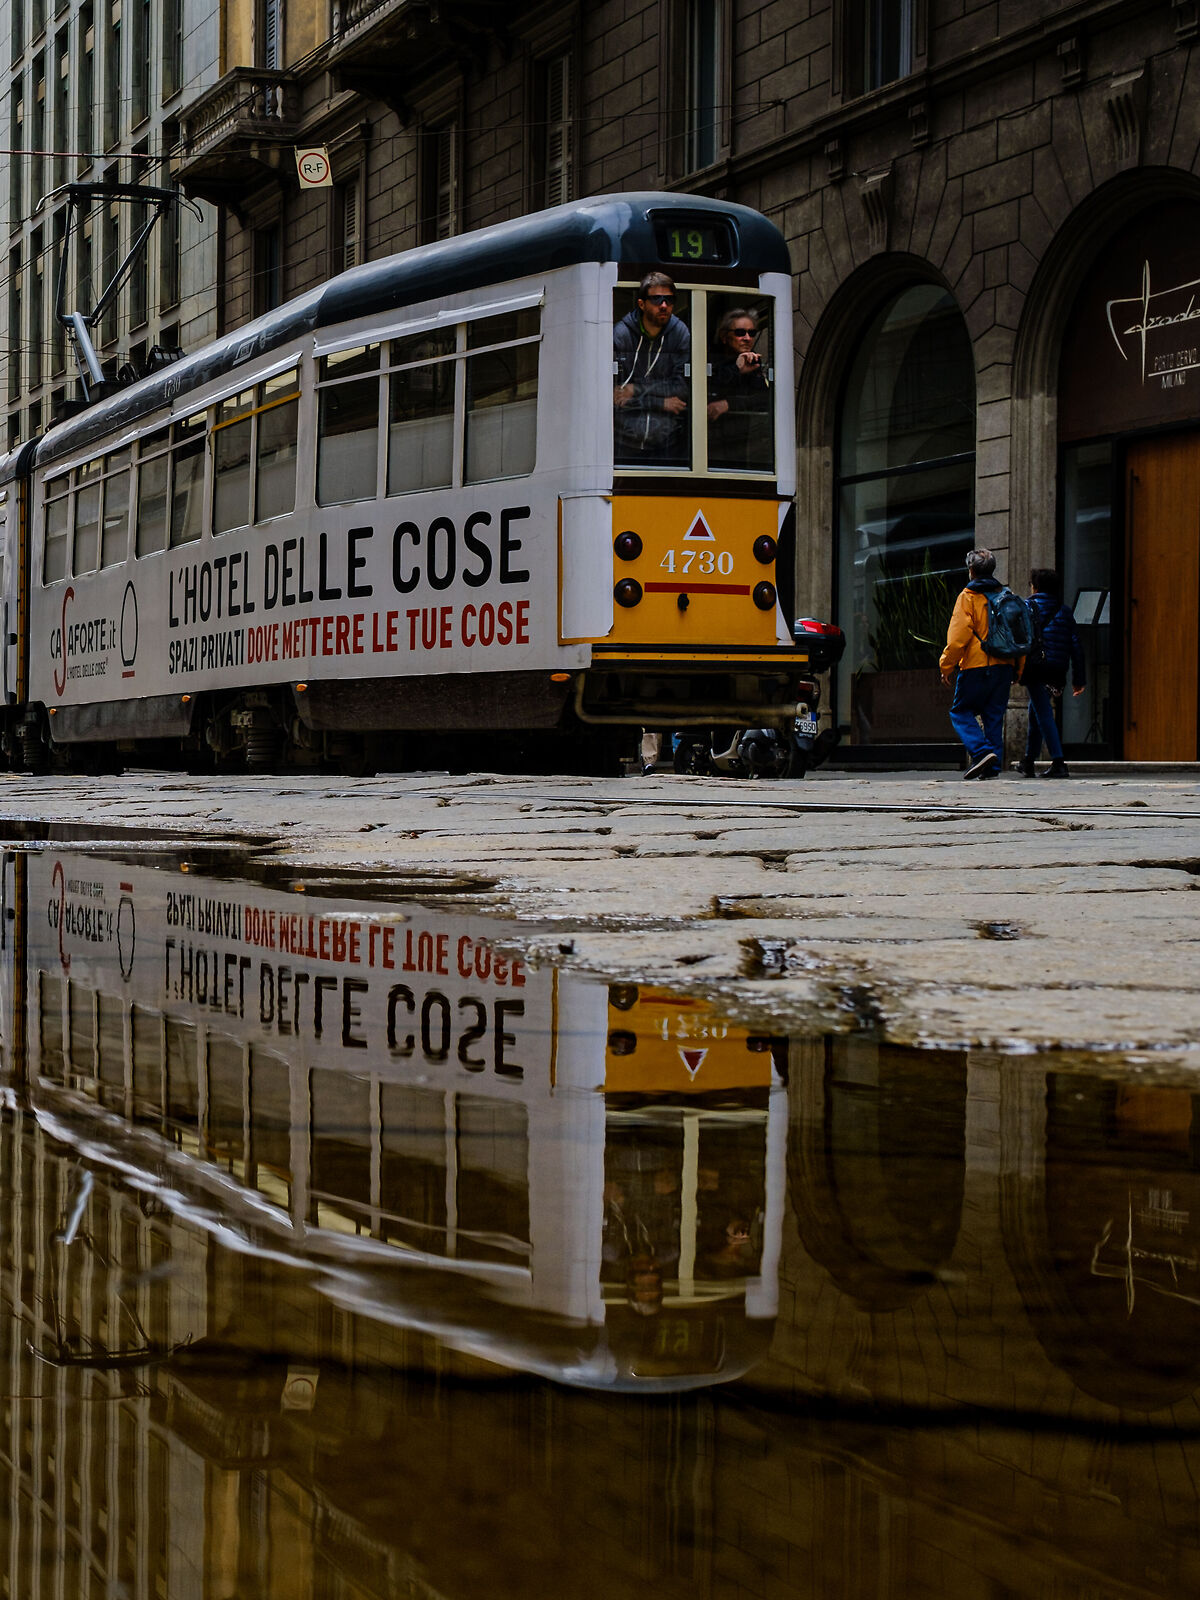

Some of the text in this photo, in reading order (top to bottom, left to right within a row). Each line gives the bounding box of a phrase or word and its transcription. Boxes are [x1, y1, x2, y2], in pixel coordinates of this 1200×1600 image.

[303, 161, 324, 175] R-F
[670, 229, 703, 259] 19
[1154, 348, 1197, 370] PORTO CERVO
[1162, 371, 1186, 389] MILANO
[169, 505, 531, 628] L'HOTEL DELLE COSE
[660, 549, 734, 576] 4730
[50, 586, 116, 697] CASAFORTE.it
[169, 600, 530, 675] SPAZI PRIVATI DOVE METTERE LE TUE COSE
[82, 663, 94, 678] DELLE
